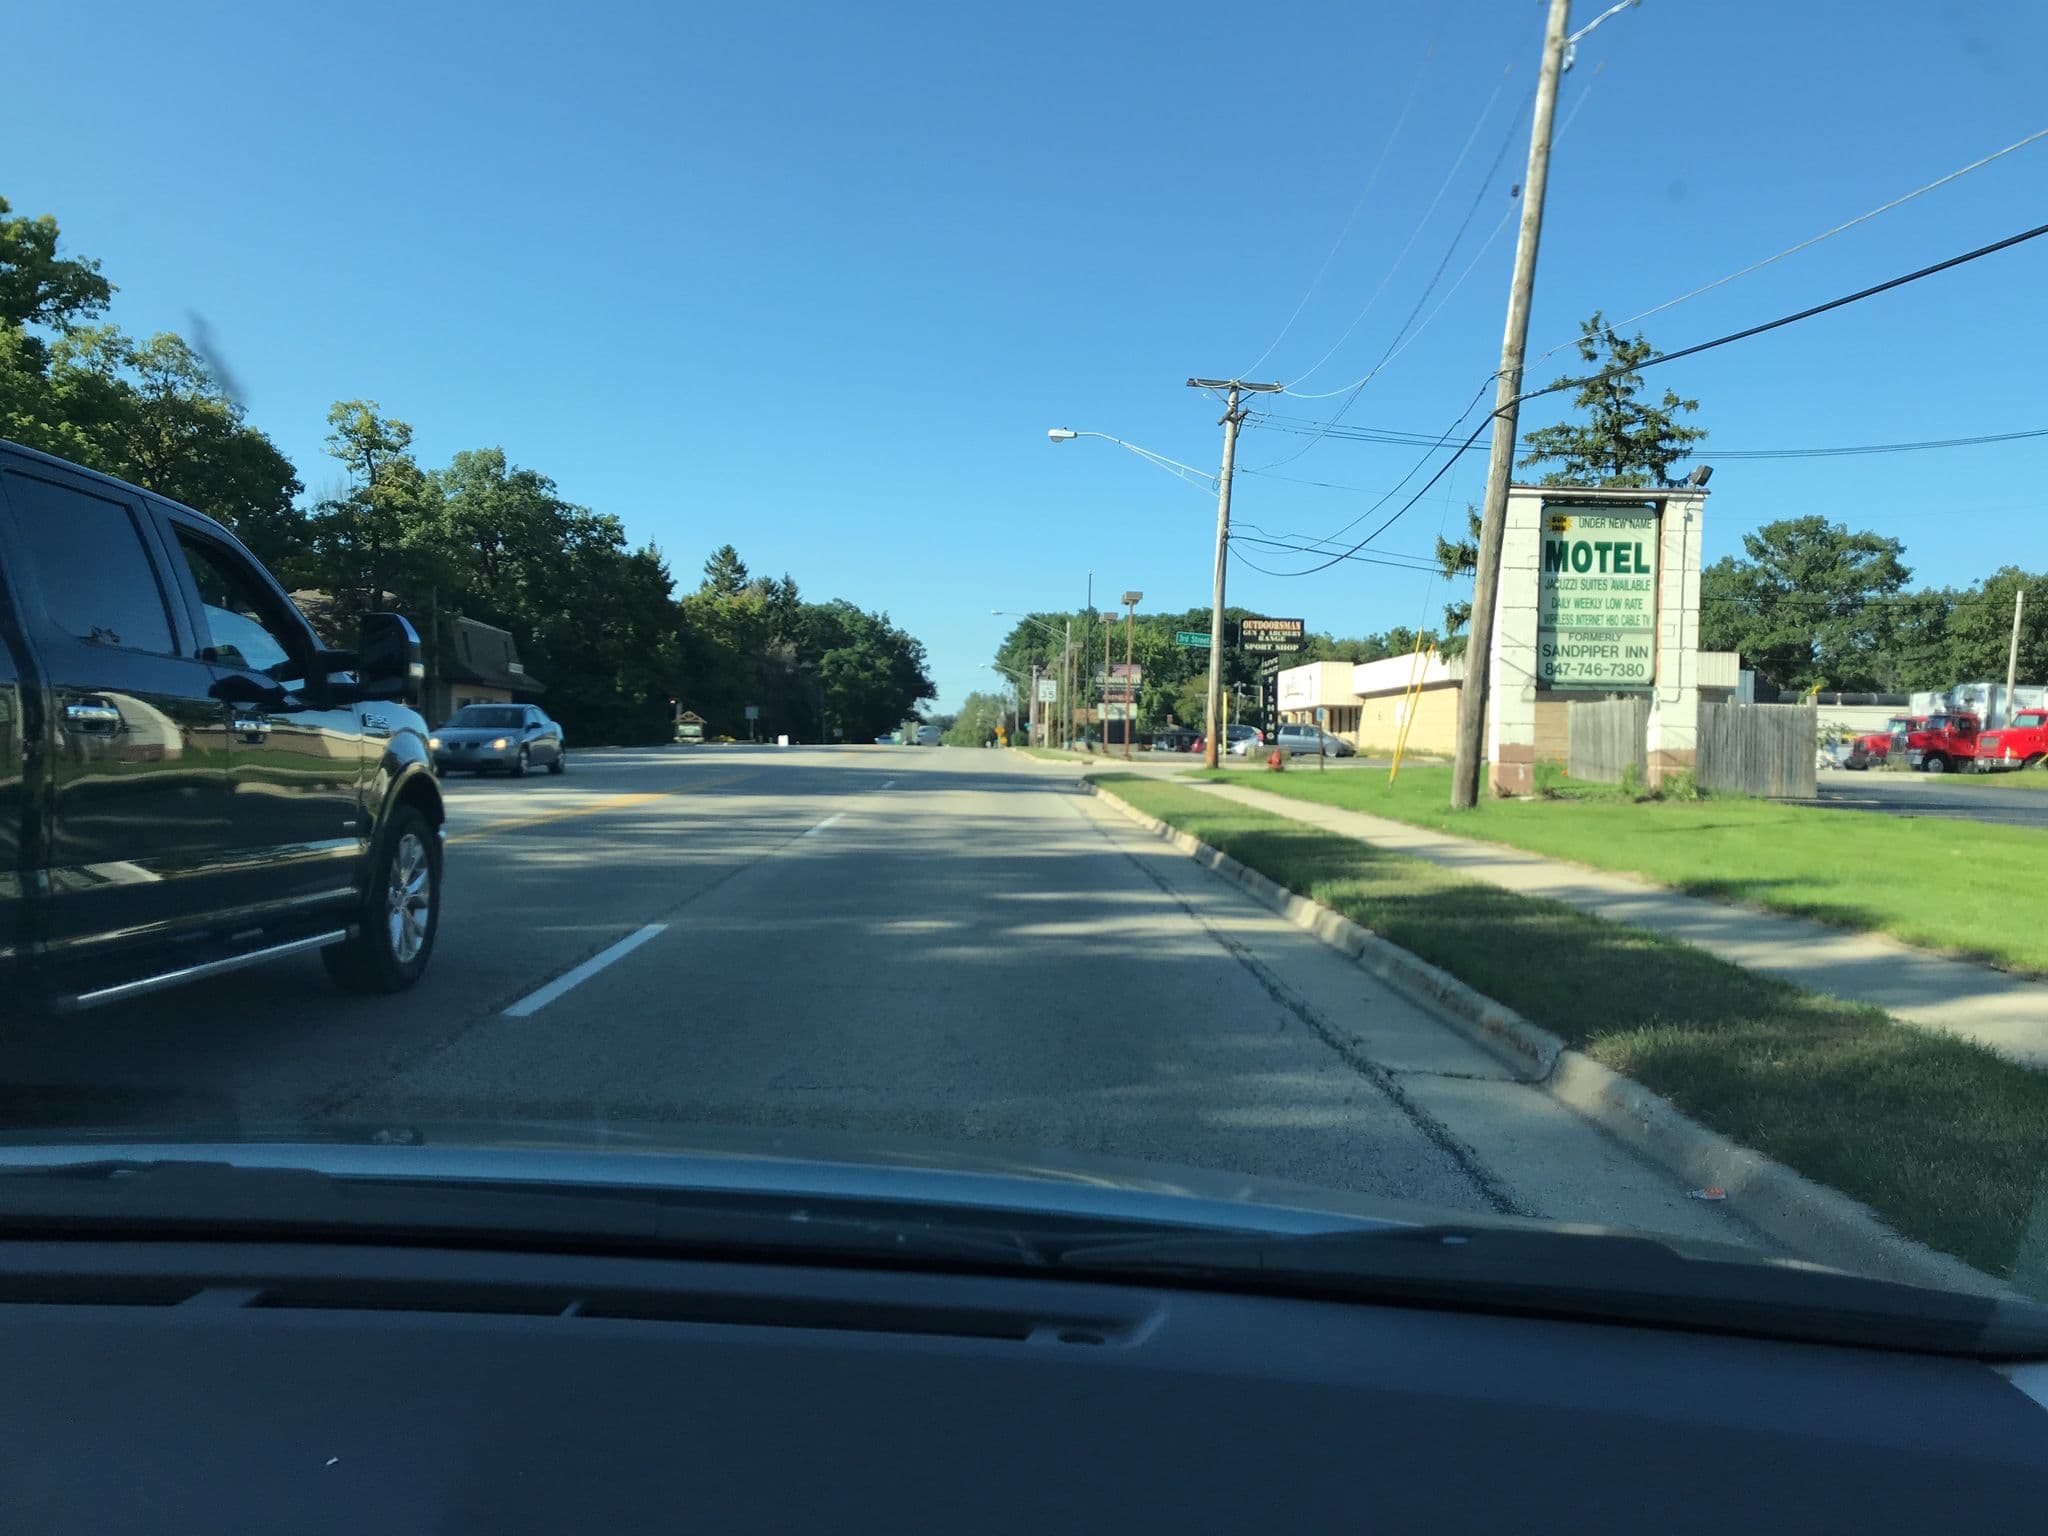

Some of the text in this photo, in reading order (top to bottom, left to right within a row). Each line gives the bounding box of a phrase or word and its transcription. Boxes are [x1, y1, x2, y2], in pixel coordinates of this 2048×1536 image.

[1579, 517, 1652, 529] UNDER NEW NAME
[1545, 540, 1650, 573] MOTEL
[1545, 579, 1651, 591] JACUZZI SUITES AVAILABLE
[1551, 598, 1643, 610] DAILY WEEKLY LOW RATE
[1242, 620, 1301, 630] OUTDOORSMAN
[1544, 614, 1651, 626] WIRELESS INTERNET HBO CABLE TV
[1178, 635, 1210, 644] 3rd Street
[1568, 632, 1623, 642] FORMERLY
[1542, 644, 1649, 658] SANDPIPER INN
[1545, 663, 1645, 677] 847-746-7380
